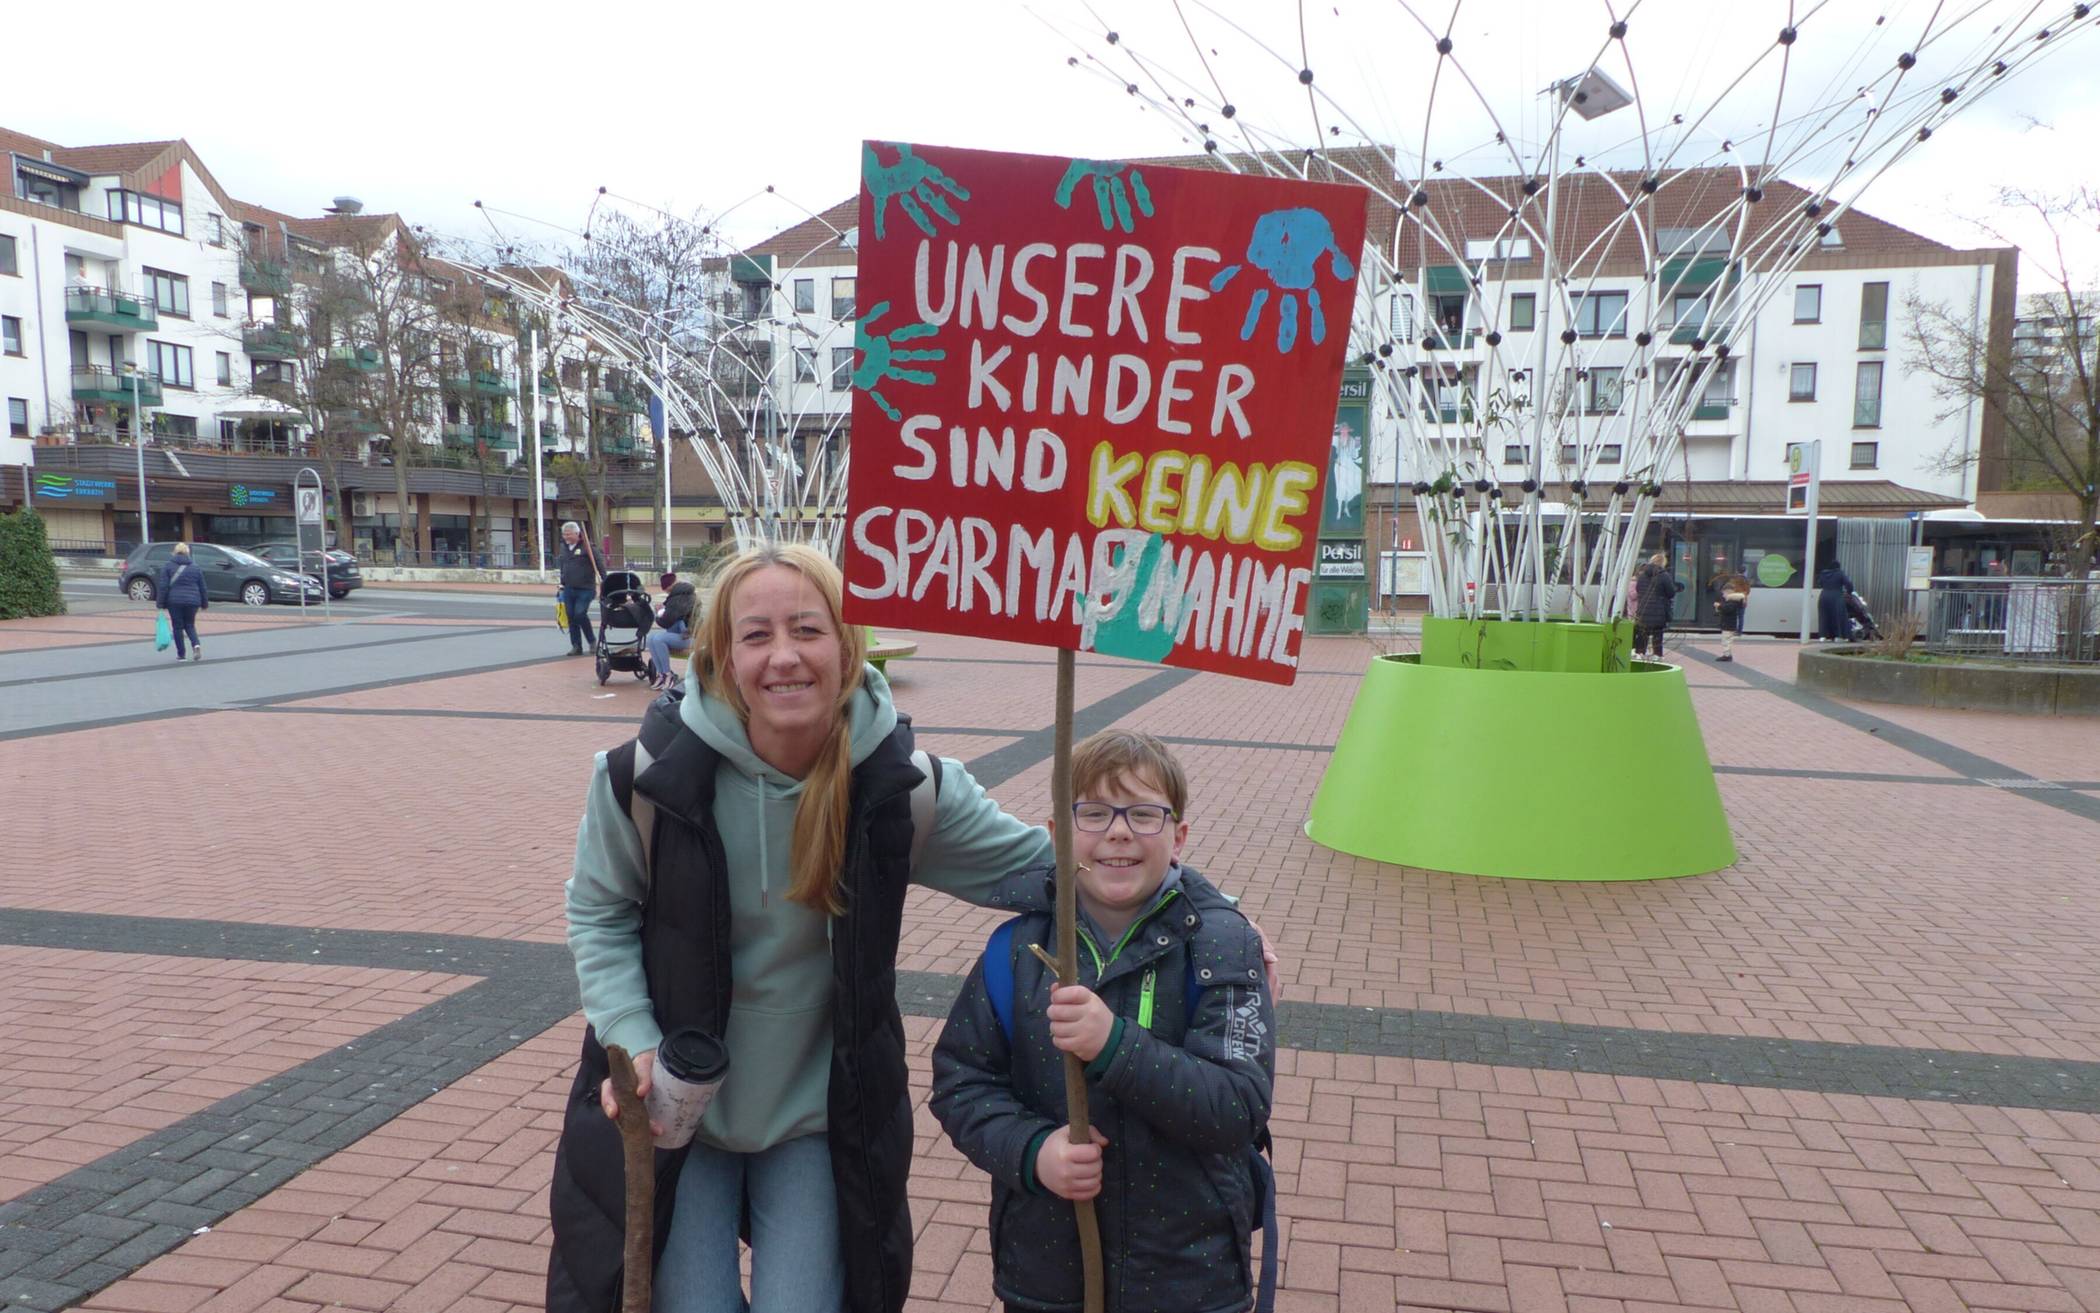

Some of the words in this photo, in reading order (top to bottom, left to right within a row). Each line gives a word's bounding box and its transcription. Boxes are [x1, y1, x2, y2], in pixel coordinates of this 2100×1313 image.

[914, 239, 1221, 345] UNSERE
[968, 339, 1255, 439] KINDER
[1340, 381, 1367, 397] ersil
[893, 414, 1067, 492] SIND
[1087, 441, 1318, 550] KEINE
[1322, 544, 1362, 560] Persil
[1231, 1017, 1248, 1062] CREW
